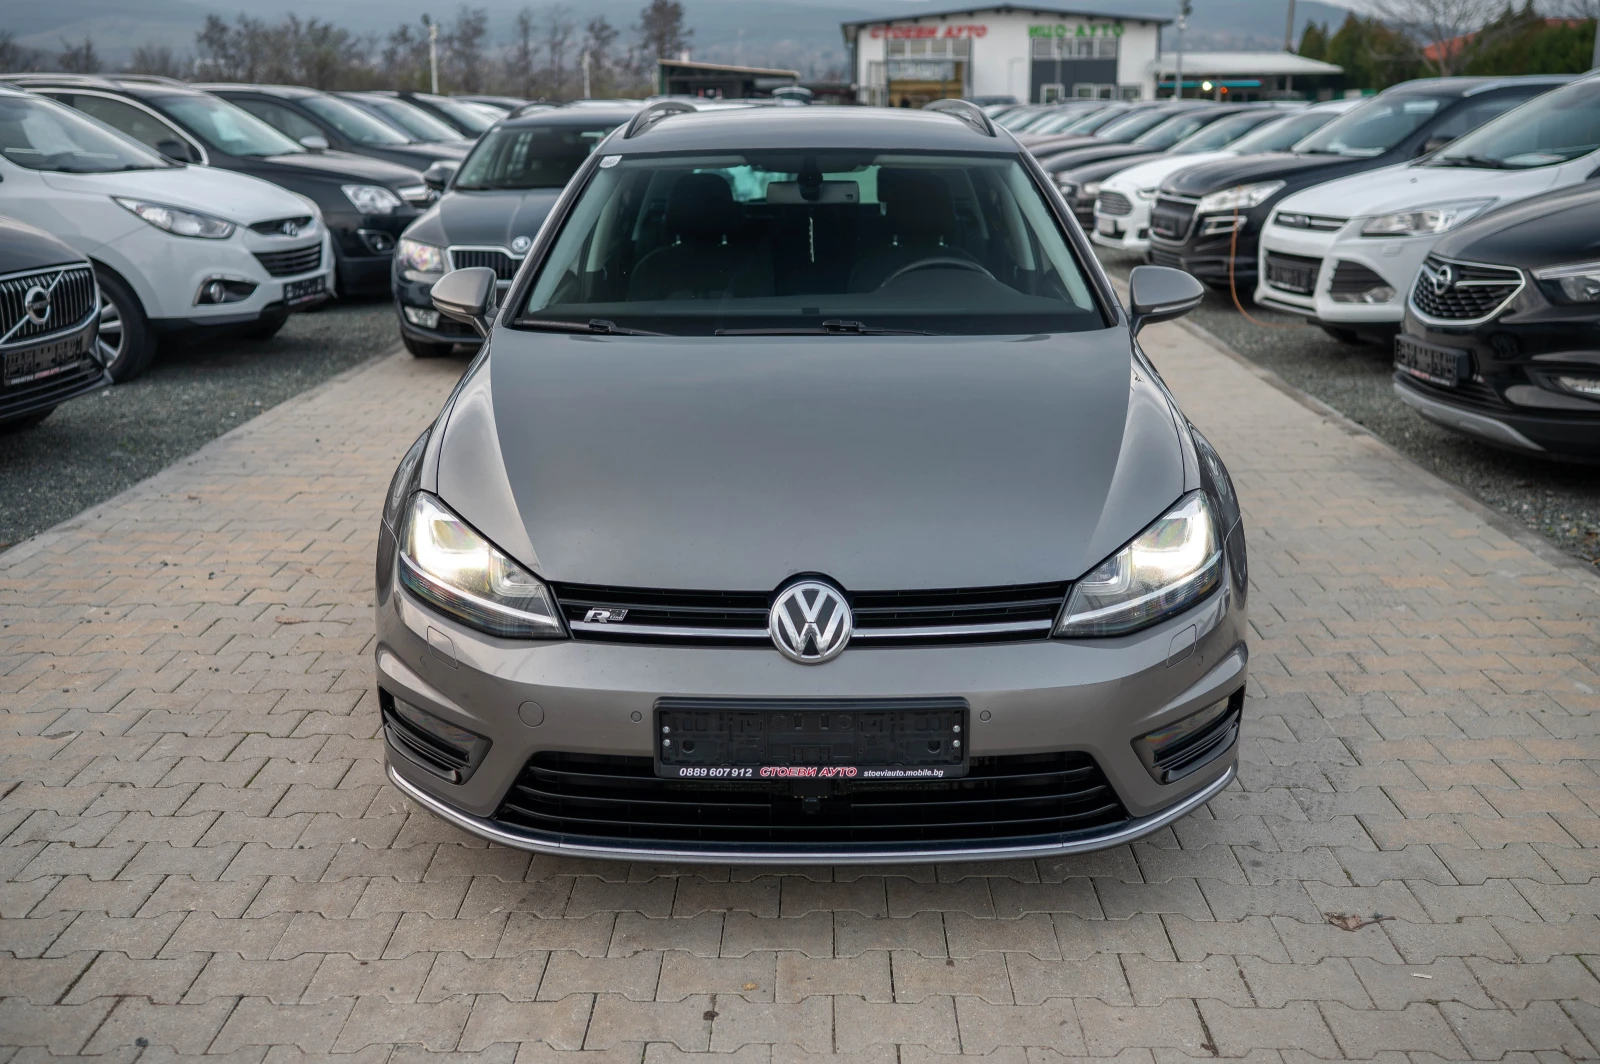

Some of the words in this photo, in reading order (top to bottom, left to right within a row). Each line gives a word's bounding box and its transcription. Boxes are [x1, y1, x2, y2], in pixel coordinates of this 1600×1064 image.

[679, 768, 707, 777] 0889
[709, 768, 731, 777] 607
[731, 768, 753, 777] 912
[759, 766, 818, 777] СТОЕВИ
[818, 766, 858, 777] АУТО
[863, 769, 944, 777] stoeviauto.mobile.bg
